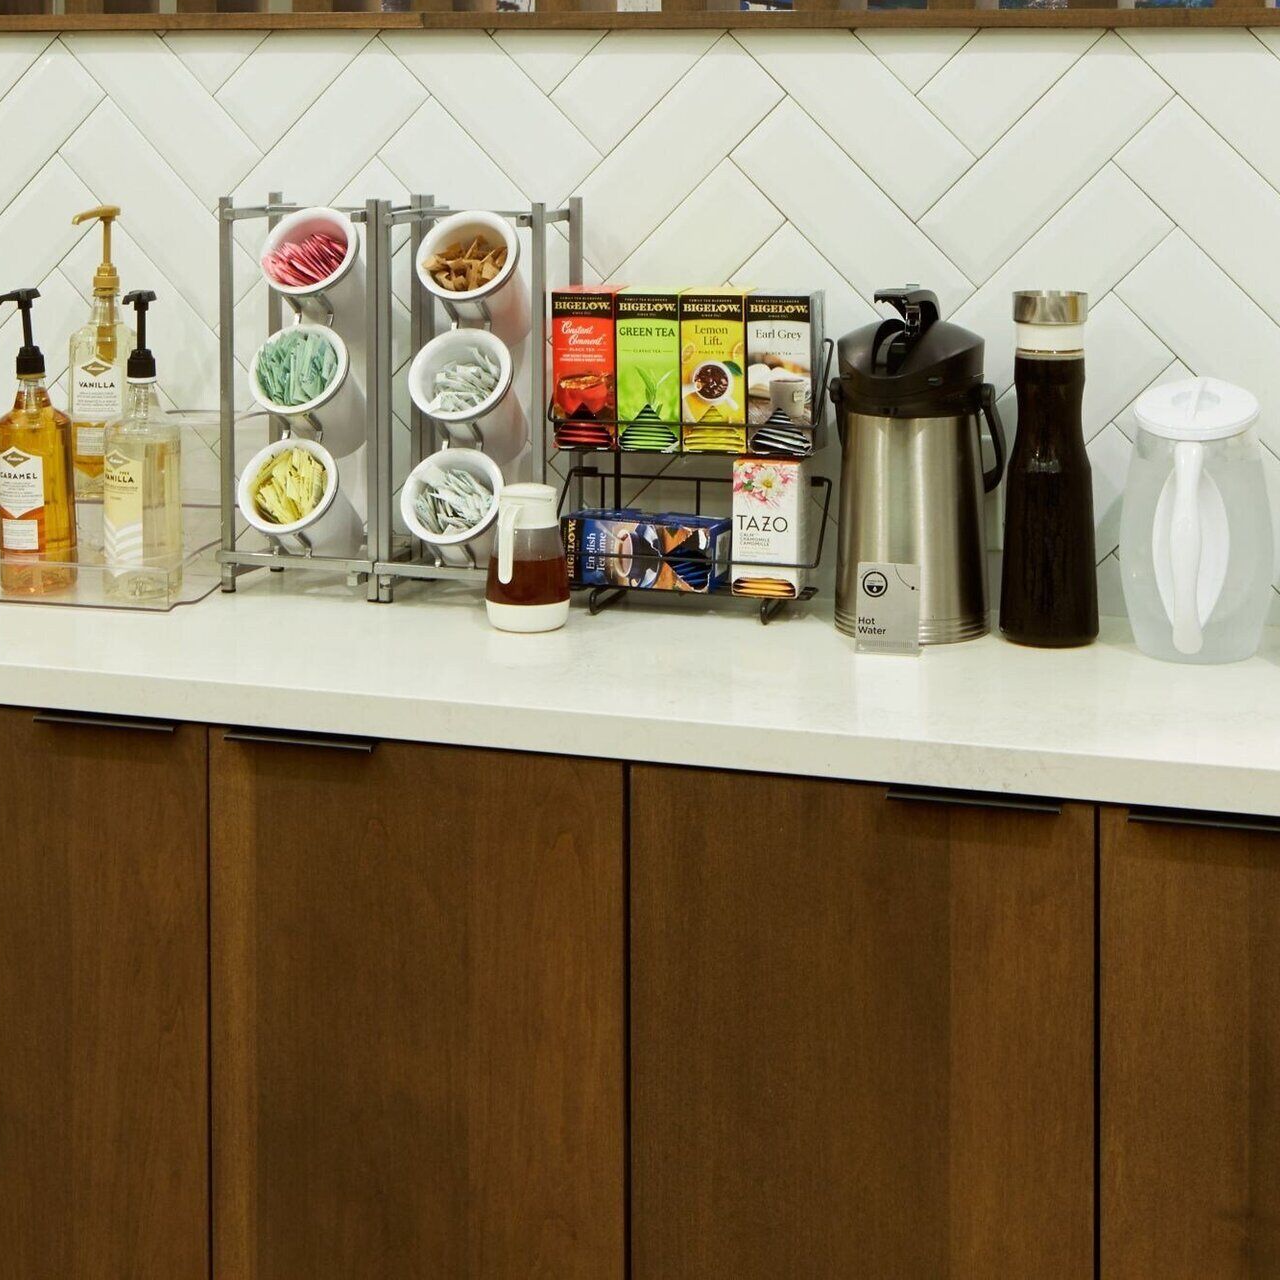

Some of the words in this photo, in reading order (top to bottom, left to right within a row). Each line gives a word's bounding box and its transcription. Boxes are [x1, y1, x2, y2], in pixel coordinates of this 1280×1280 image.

[554, 301, 611, 311] BIGELOW
[619, 302, 677, 312] BIGELOW
[683, 303, 740, 313] BIGELOW
[750, 304, 808, 314] BIGELOW
[619, 327, 653, 337] GREEN
[655, 328, 676, 337] TEA
[694, 324, 729, 335] Lemon
[756, 329, 775, 339] Earl
[778, 330, 802, 341] Grey
[79, 381, 115, 389] VANILLA
[0, 471, 38, 480] CARAMEL
[736, 514, 788, 533] TAZO
[596, 532, 608, 571] Teaime
[858, 616, 875, 625] Hot
[858, 626, 886, 635] Water
